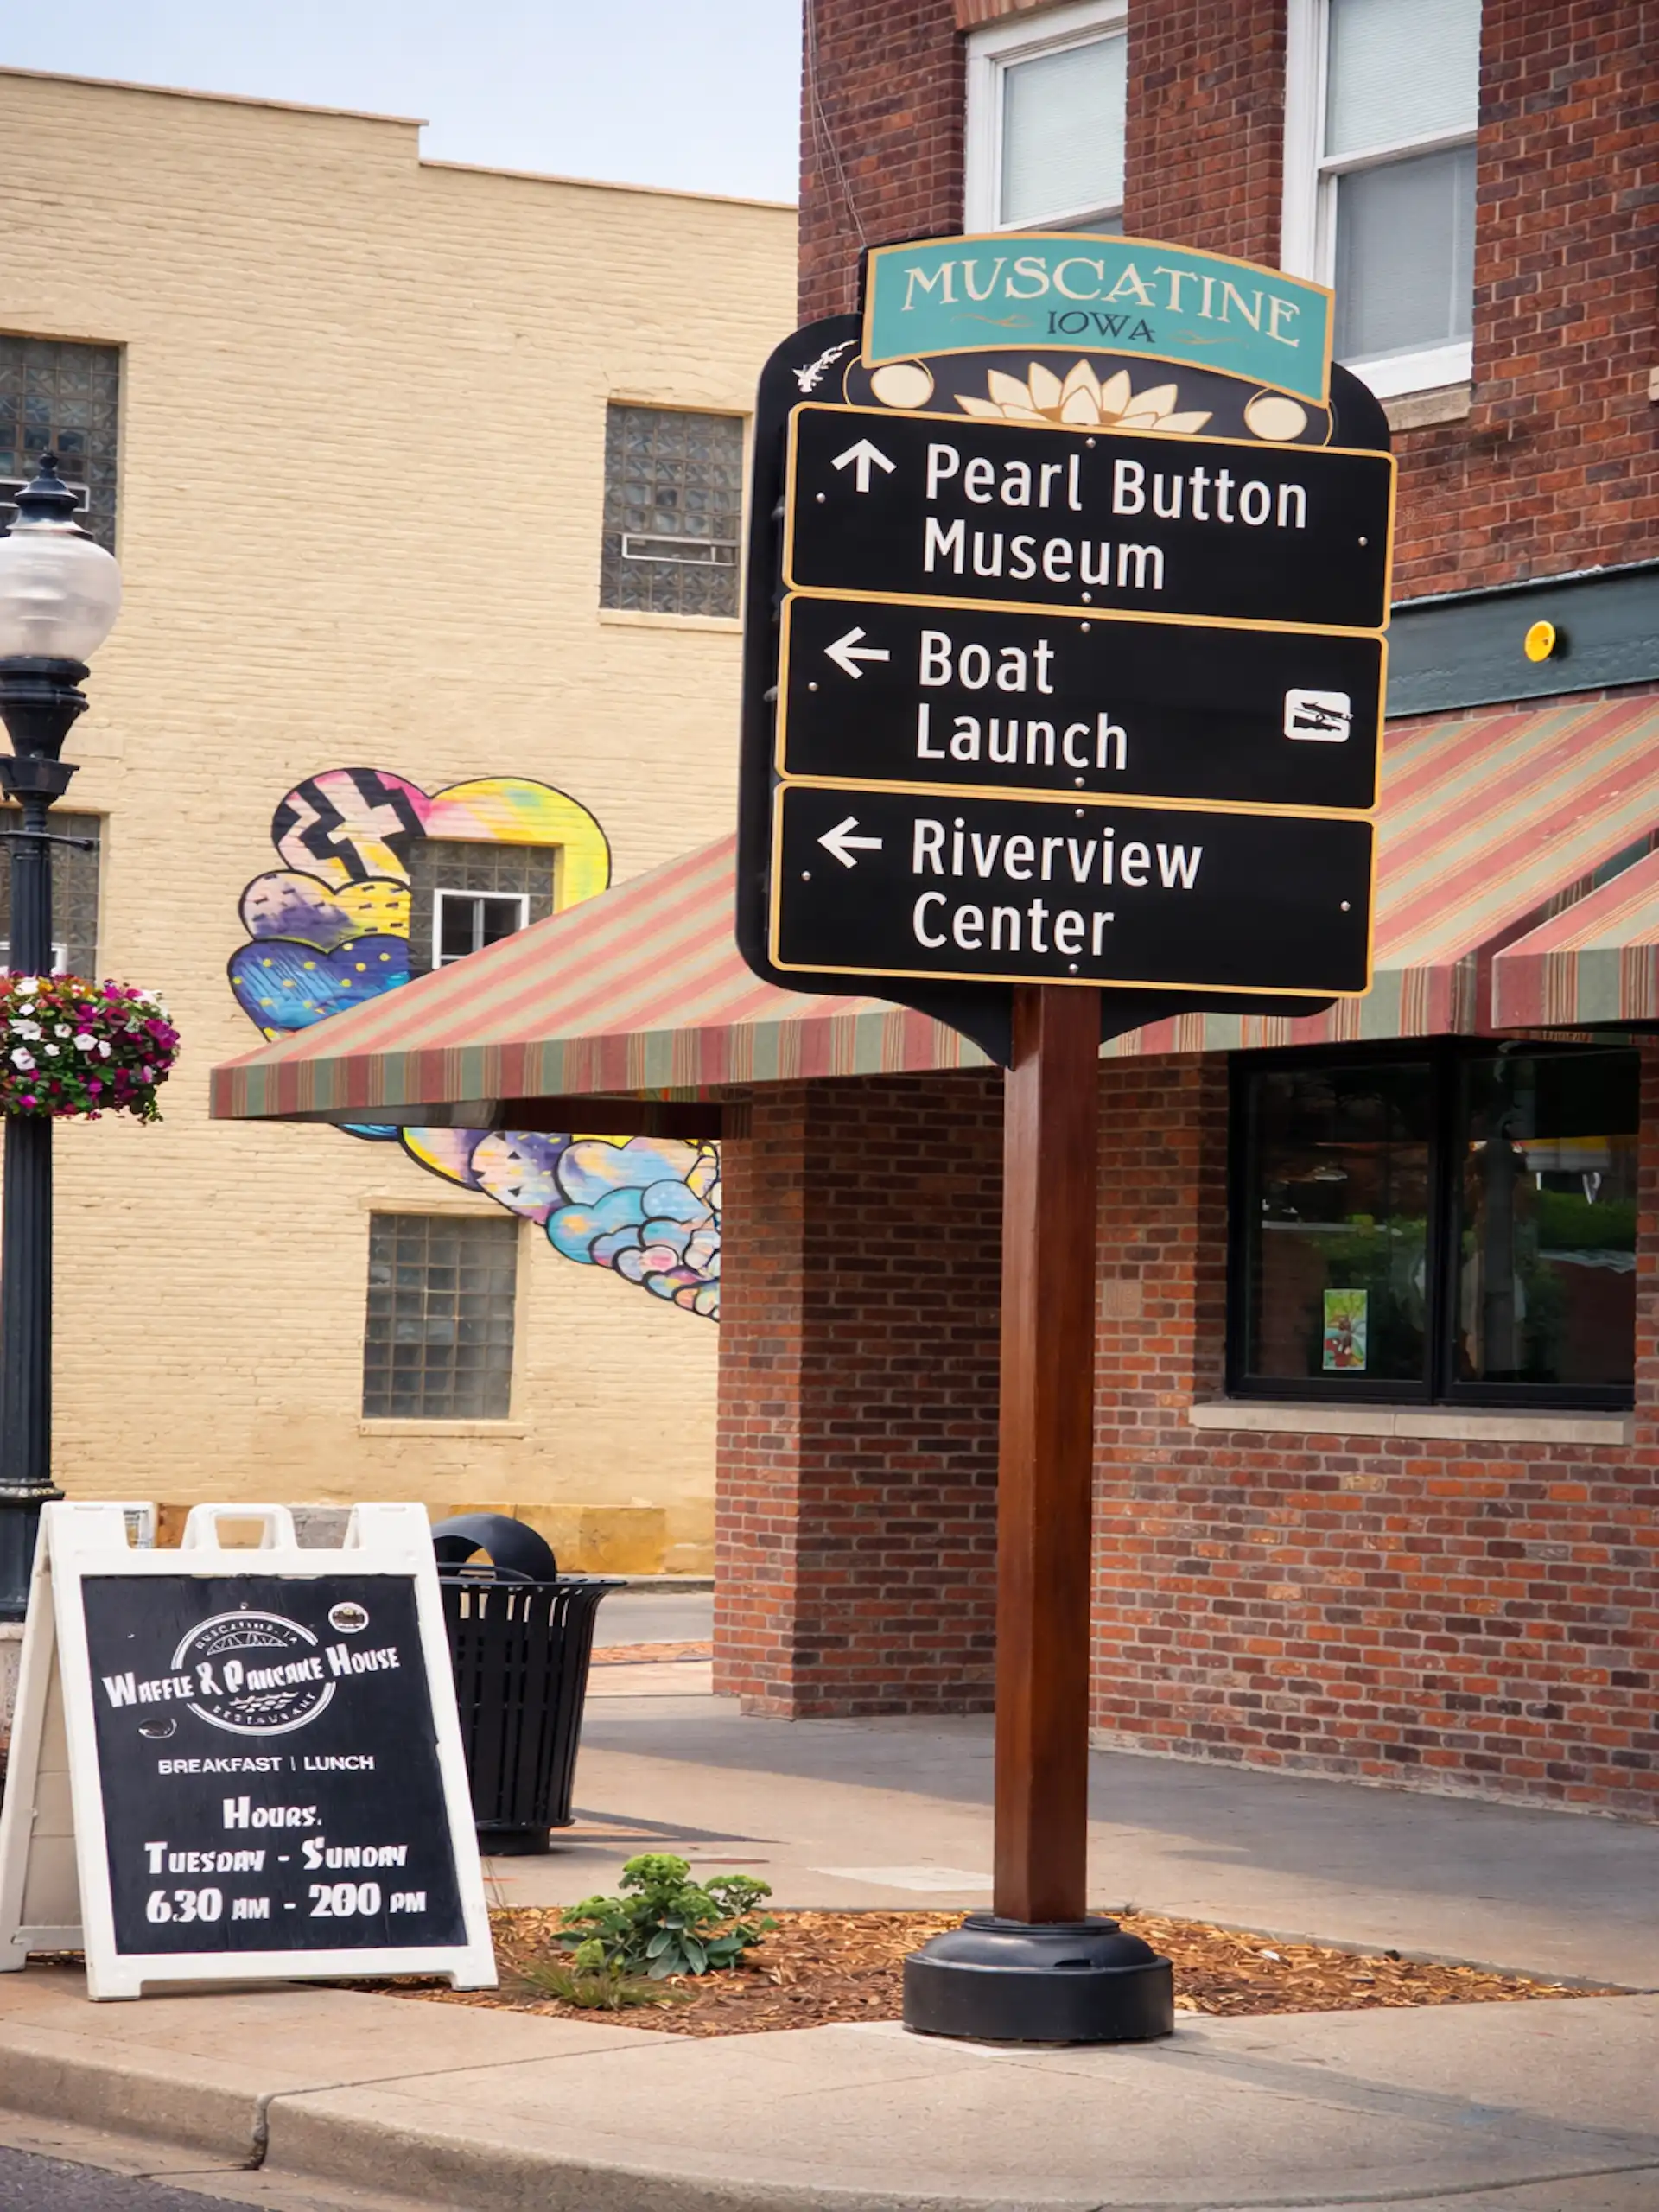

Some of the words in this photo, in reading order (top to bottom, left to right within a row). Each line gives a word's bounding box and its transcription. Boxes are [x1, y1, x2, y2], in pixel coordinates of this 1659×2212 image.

[900, 257, 1300, 347] MUSCATINE
[1046, 310, 1156, 344] IOWA
[926, 442, 1083, 512] Pearl
[1112, 458, 1309, 529] Button
[923, 517, 1166, 591] Museum
[919, 629, 1055, 695] Boat
[917, 702, 1128, 771] Launch
[912, 817, 1204, 889] Riverview
[912, 891, 1115, 956] Center
[157, 1756, 283, 1775] BREAKFAST
[303, 1755, 375, 1771] LUNCH
